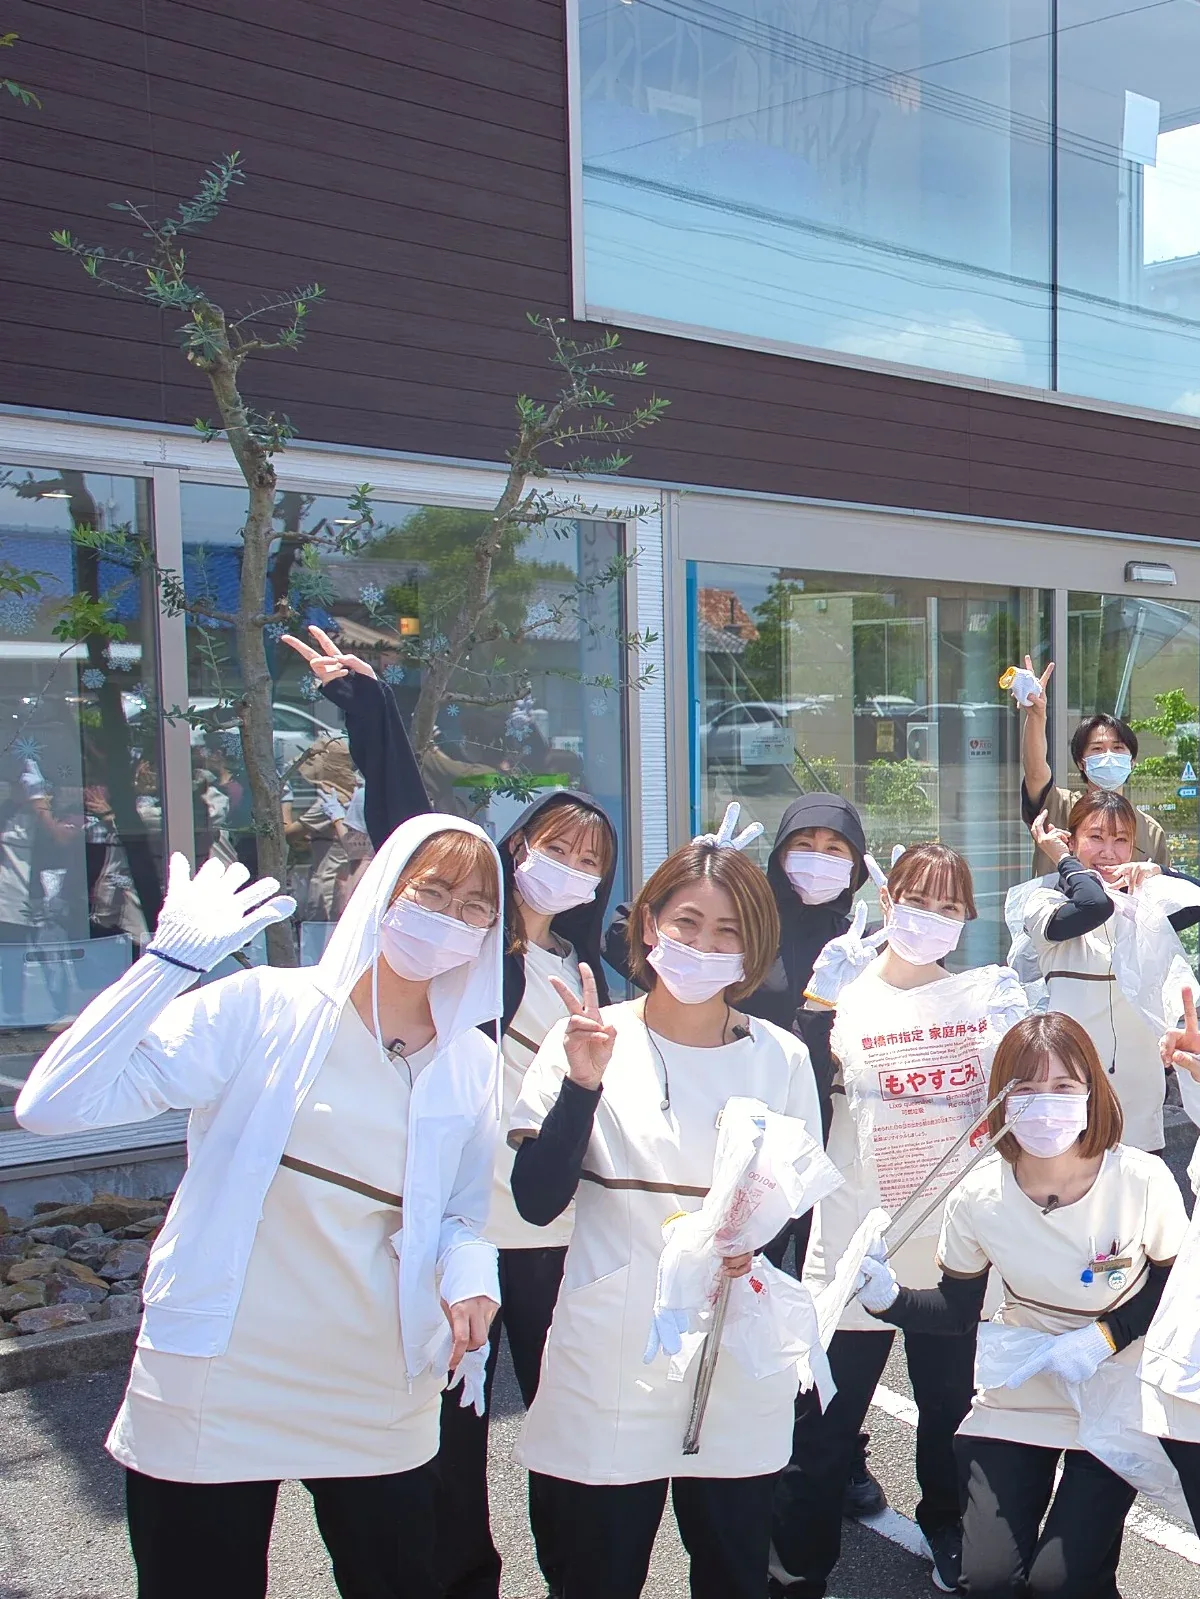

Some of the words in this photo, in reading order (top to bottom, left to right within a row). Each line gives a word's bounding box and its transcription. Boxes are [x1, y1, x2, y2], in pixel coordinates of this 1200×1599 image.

[862, 1029, 924, 1050] 豊橋市指定
[886, 1062, 978, 1094] もやすごみ
